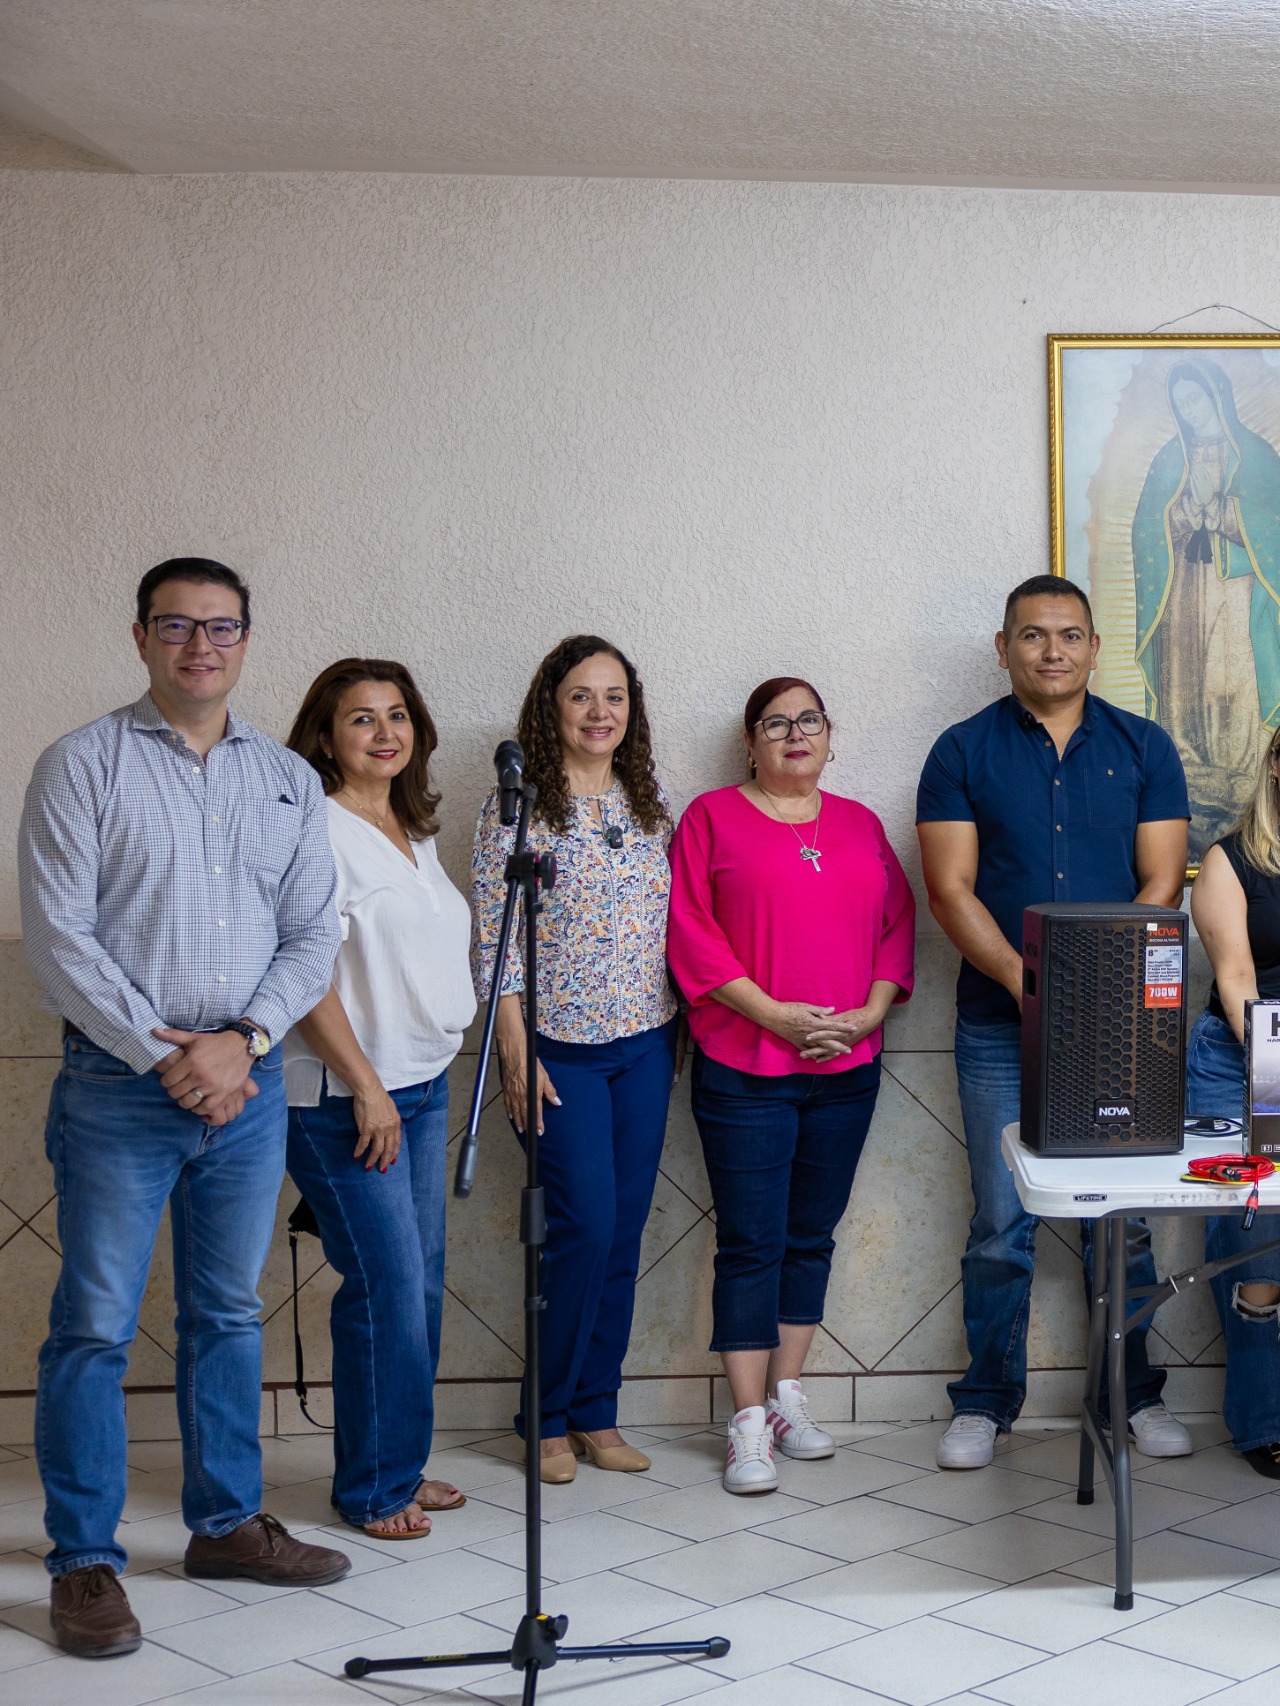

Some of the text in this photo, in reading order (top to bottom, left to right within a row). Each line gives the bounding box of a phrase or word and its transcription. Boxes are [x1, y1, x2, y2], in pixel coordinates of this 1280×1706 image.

[1149, 928, 1179, 937] NOVA
[1149, 987, 1178, 997] 700W
[1099, 1107, 1130, 1116] NOVA
